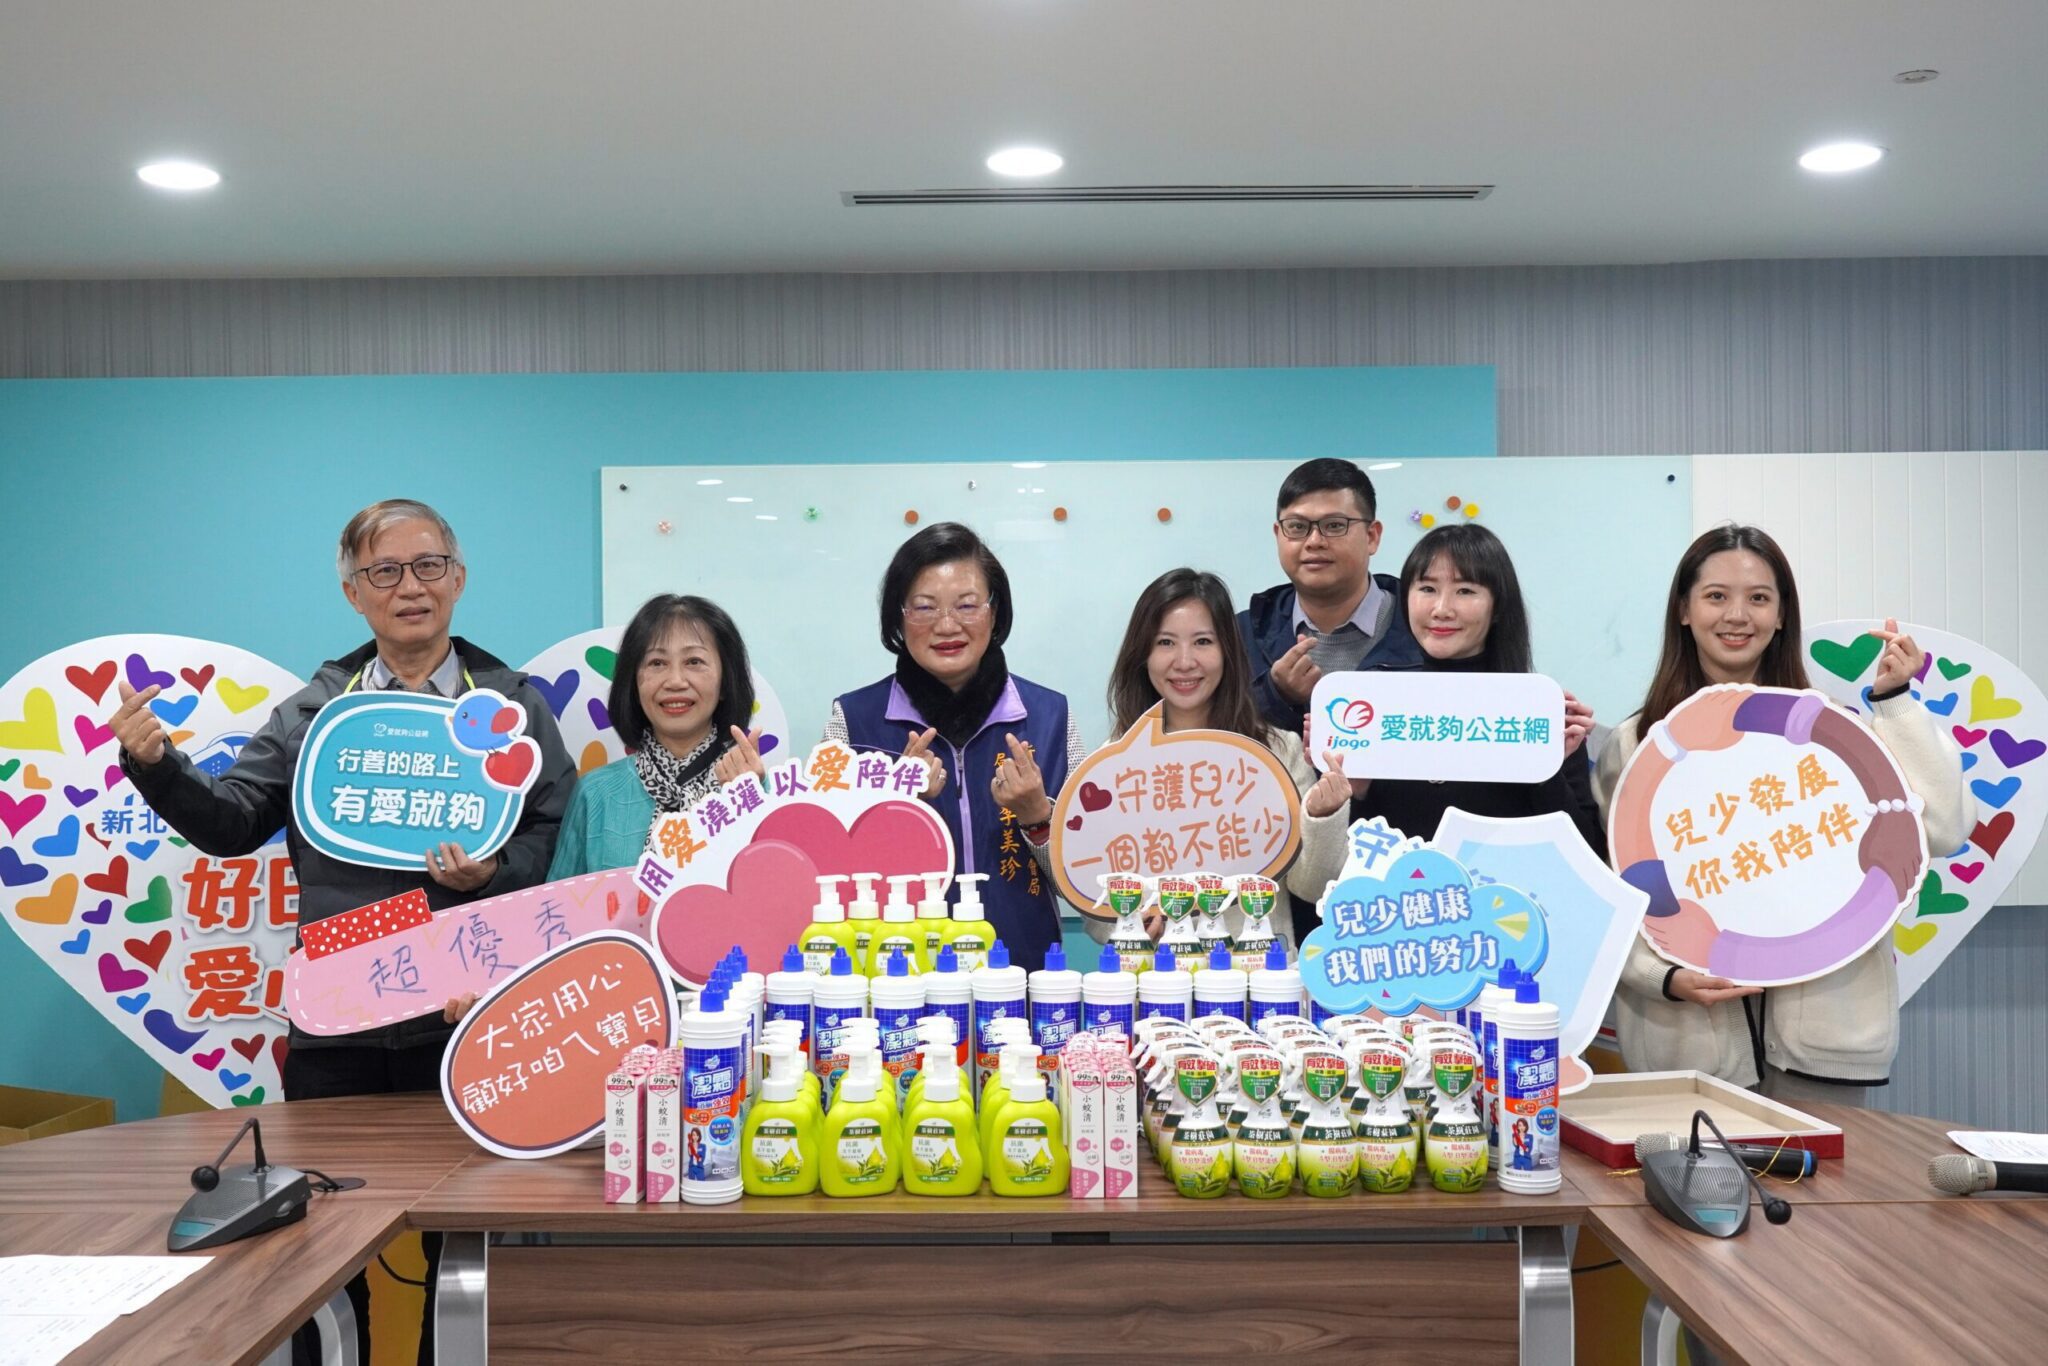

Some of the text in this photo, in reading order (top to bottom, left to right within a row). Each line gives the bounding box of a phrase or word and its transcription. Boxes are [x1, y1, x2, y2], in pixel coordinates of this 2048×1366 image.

[1327, 735, 1370, 750] ijogo
[1380, 714, 1550, 744] 愛就夠公益網
[337, 748, 460, 778] 行善的路上
[1115, 758, 1258, 814] 守護兒少
[331, 785, 486, 831] 有愛就夠
[1666, 753, 1839, 852] 兒少發展
[1071, 807, 1285, 875] 一個都不能少
[1685, 802, 1859, 899] 你我陪伴
[1334, 885, 1470, 938] 兒少健康
[1325, 932, 1499, 985] 我們的努力
[476, 962, 624, 1058] 大家用心
[615, 1099, 625, 1126] 小蚊清
[658, 1099, 668, 1126] 小蚊清
[1082, 1095, 1092, 1122] 小蚊清
[1116, 1095, 1126, 1122] 小蚊清
